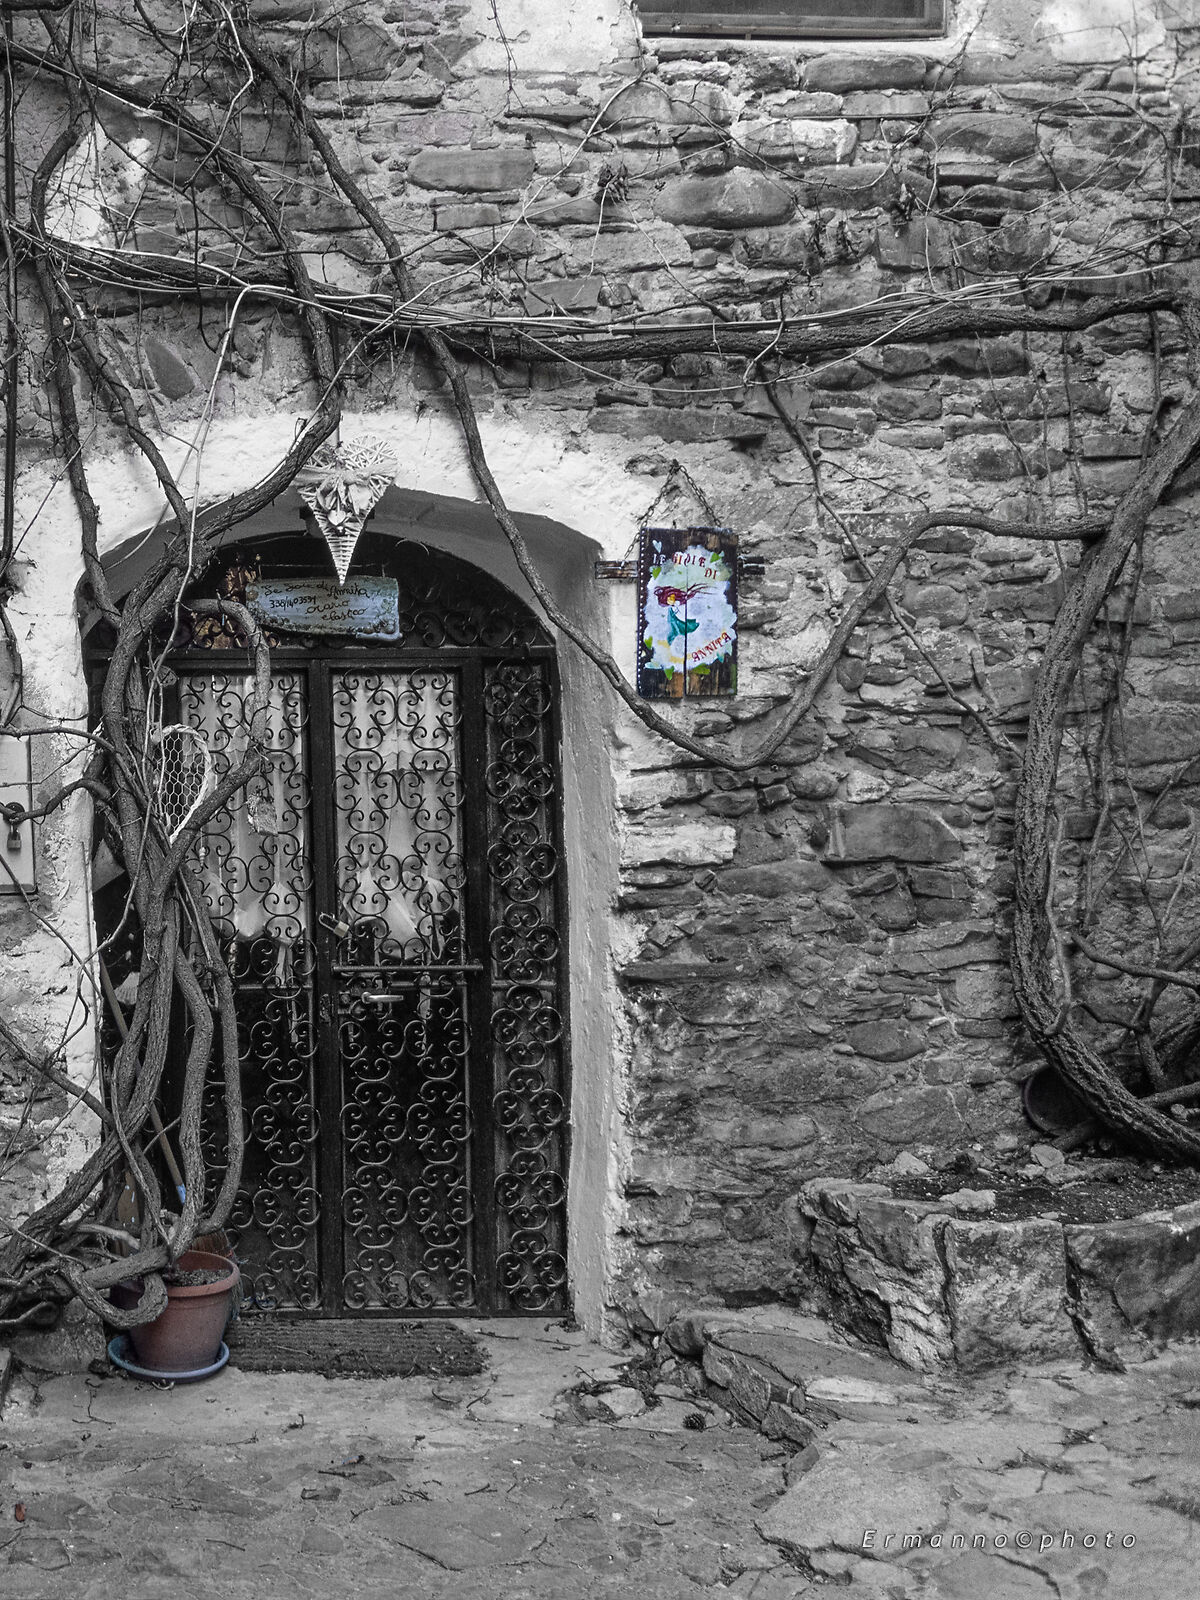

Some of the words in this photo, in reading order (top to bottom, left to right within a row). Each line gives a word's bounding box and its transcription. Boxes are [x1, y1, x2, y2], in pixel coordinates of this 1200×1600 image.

[653, 553, 666, 565] LE
[672, 553, 706, 567] GIOIE
[704, 568, 717, 580] DI
[317, 581, 329, 591] di
[691, 631, 731, 662] ANNITA
